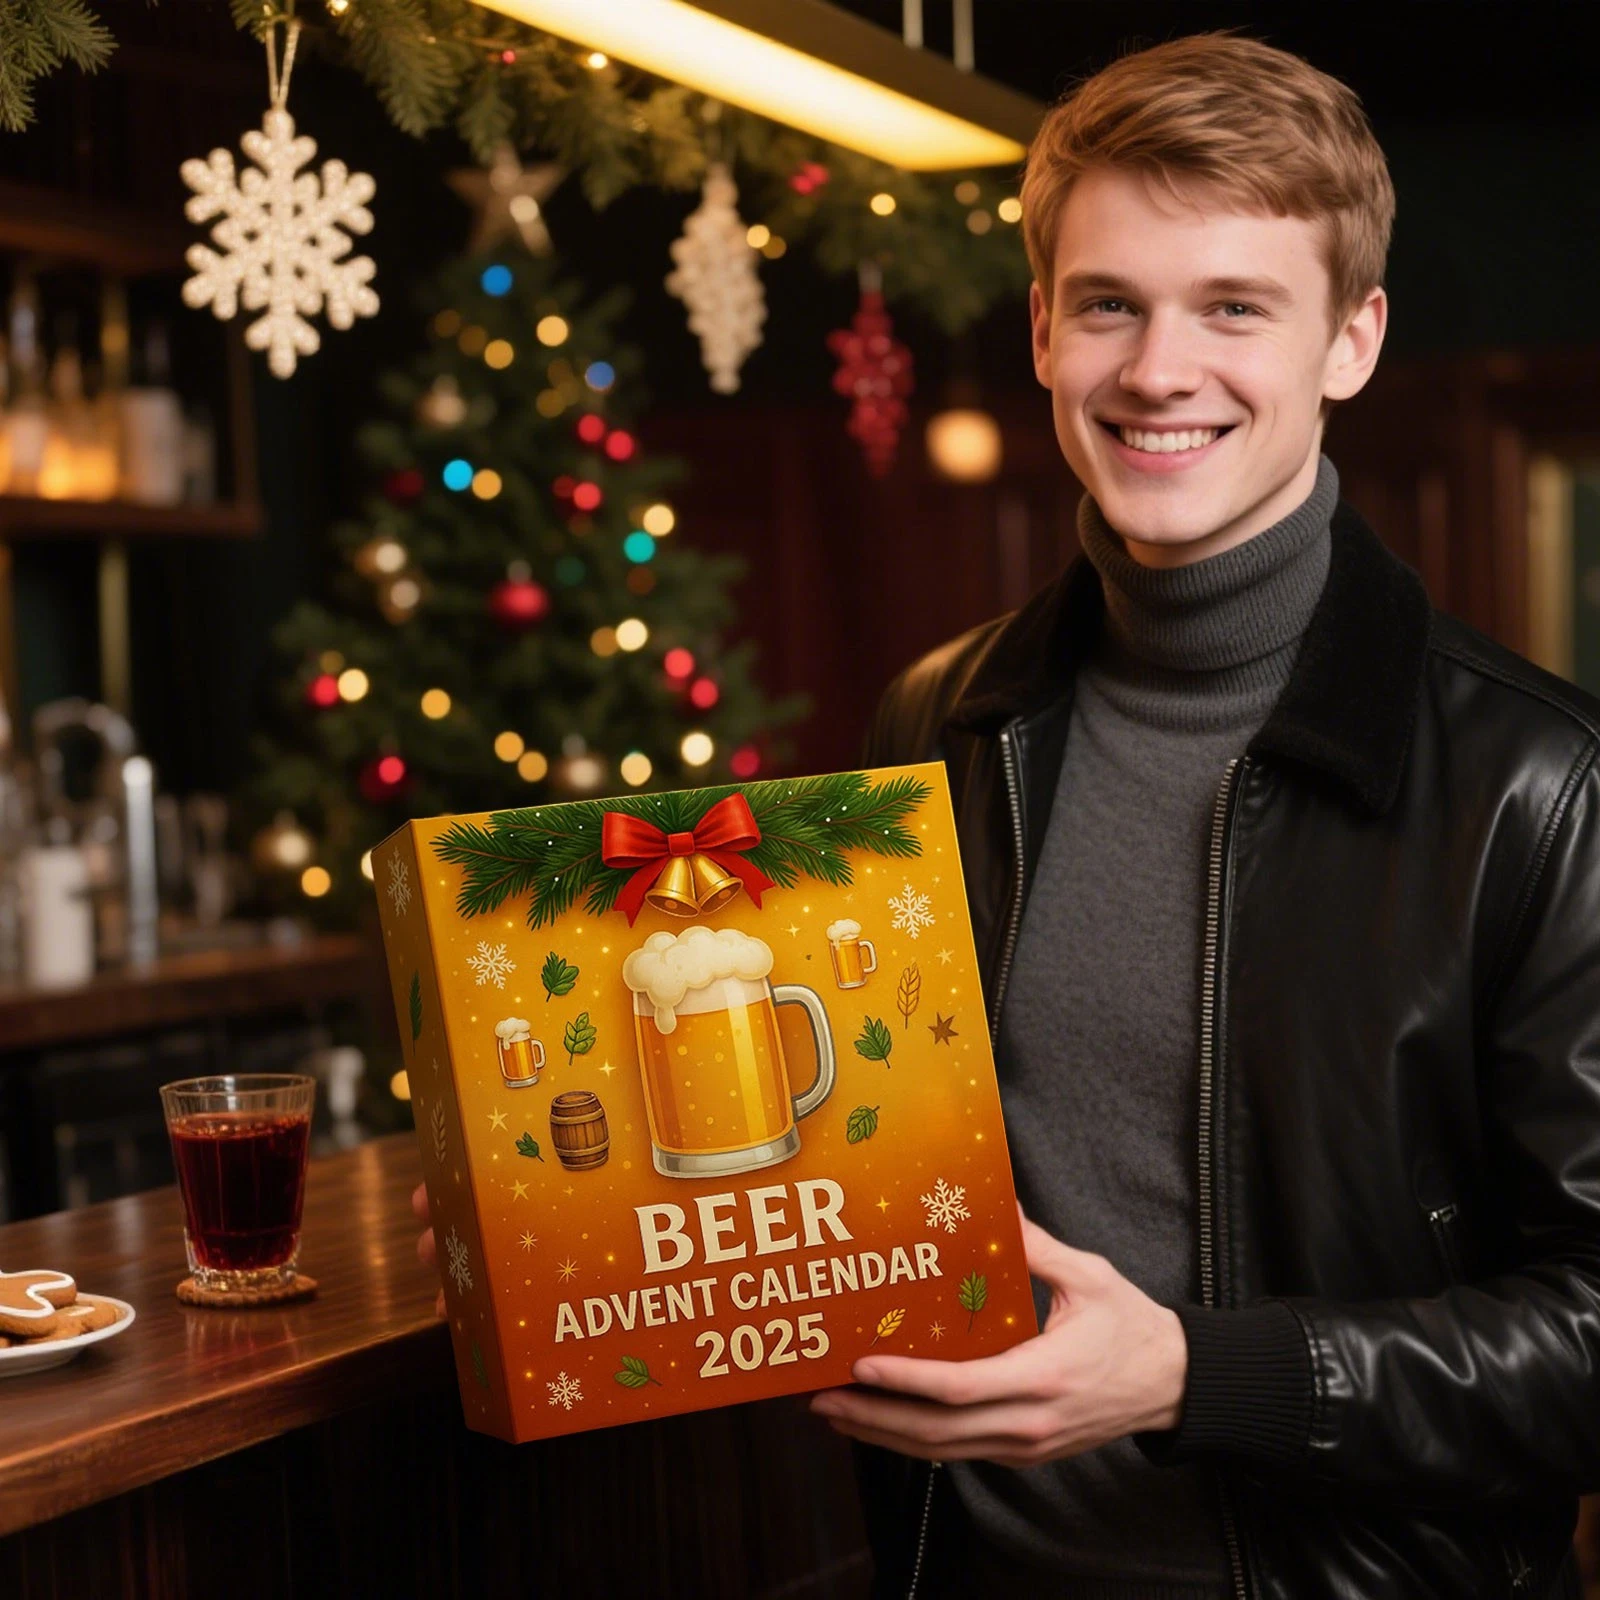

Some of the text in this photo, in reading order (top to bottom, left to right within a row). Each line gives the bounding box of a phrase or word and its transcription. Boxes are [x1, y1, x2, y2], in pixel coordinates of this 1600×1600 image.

[633, 1178, 854, 1275] BEER
[554, 1242, 943, 1343] ADVENT CALENDAR
[695, 1312, 830, 1379] 2025
